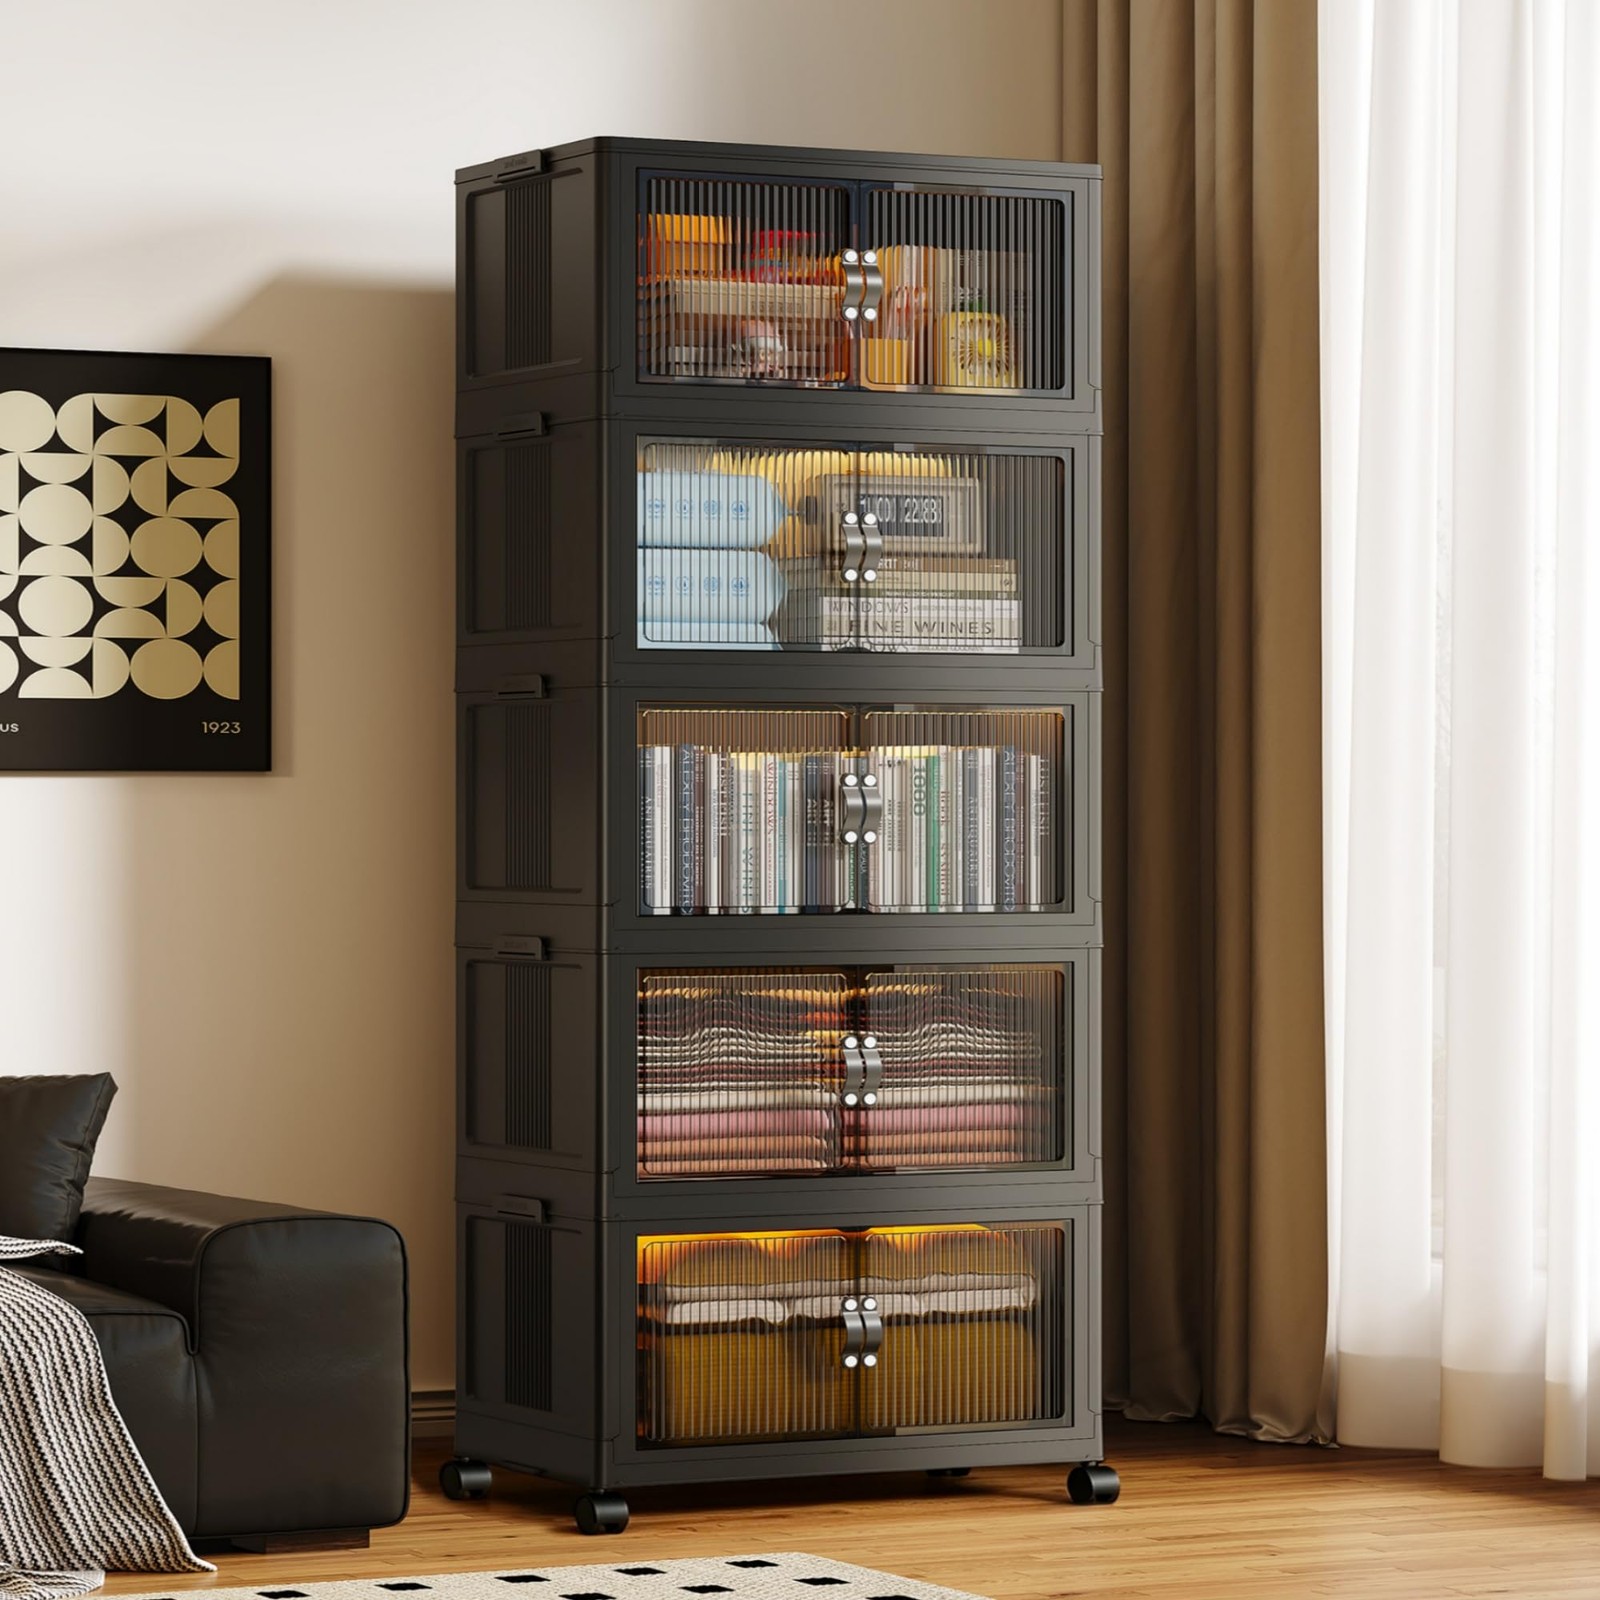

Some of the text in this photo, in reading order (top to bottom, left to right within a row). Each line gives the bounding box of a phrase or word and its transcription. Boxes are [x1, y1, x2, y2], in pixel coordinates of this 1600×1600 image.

[829, 601, 909, 614] WINDOWS
[849, 620, 993, 635] FINE WINES
[201, 721, 241, 734] 1923
[681, 749, 694, 813] ALEXEY
